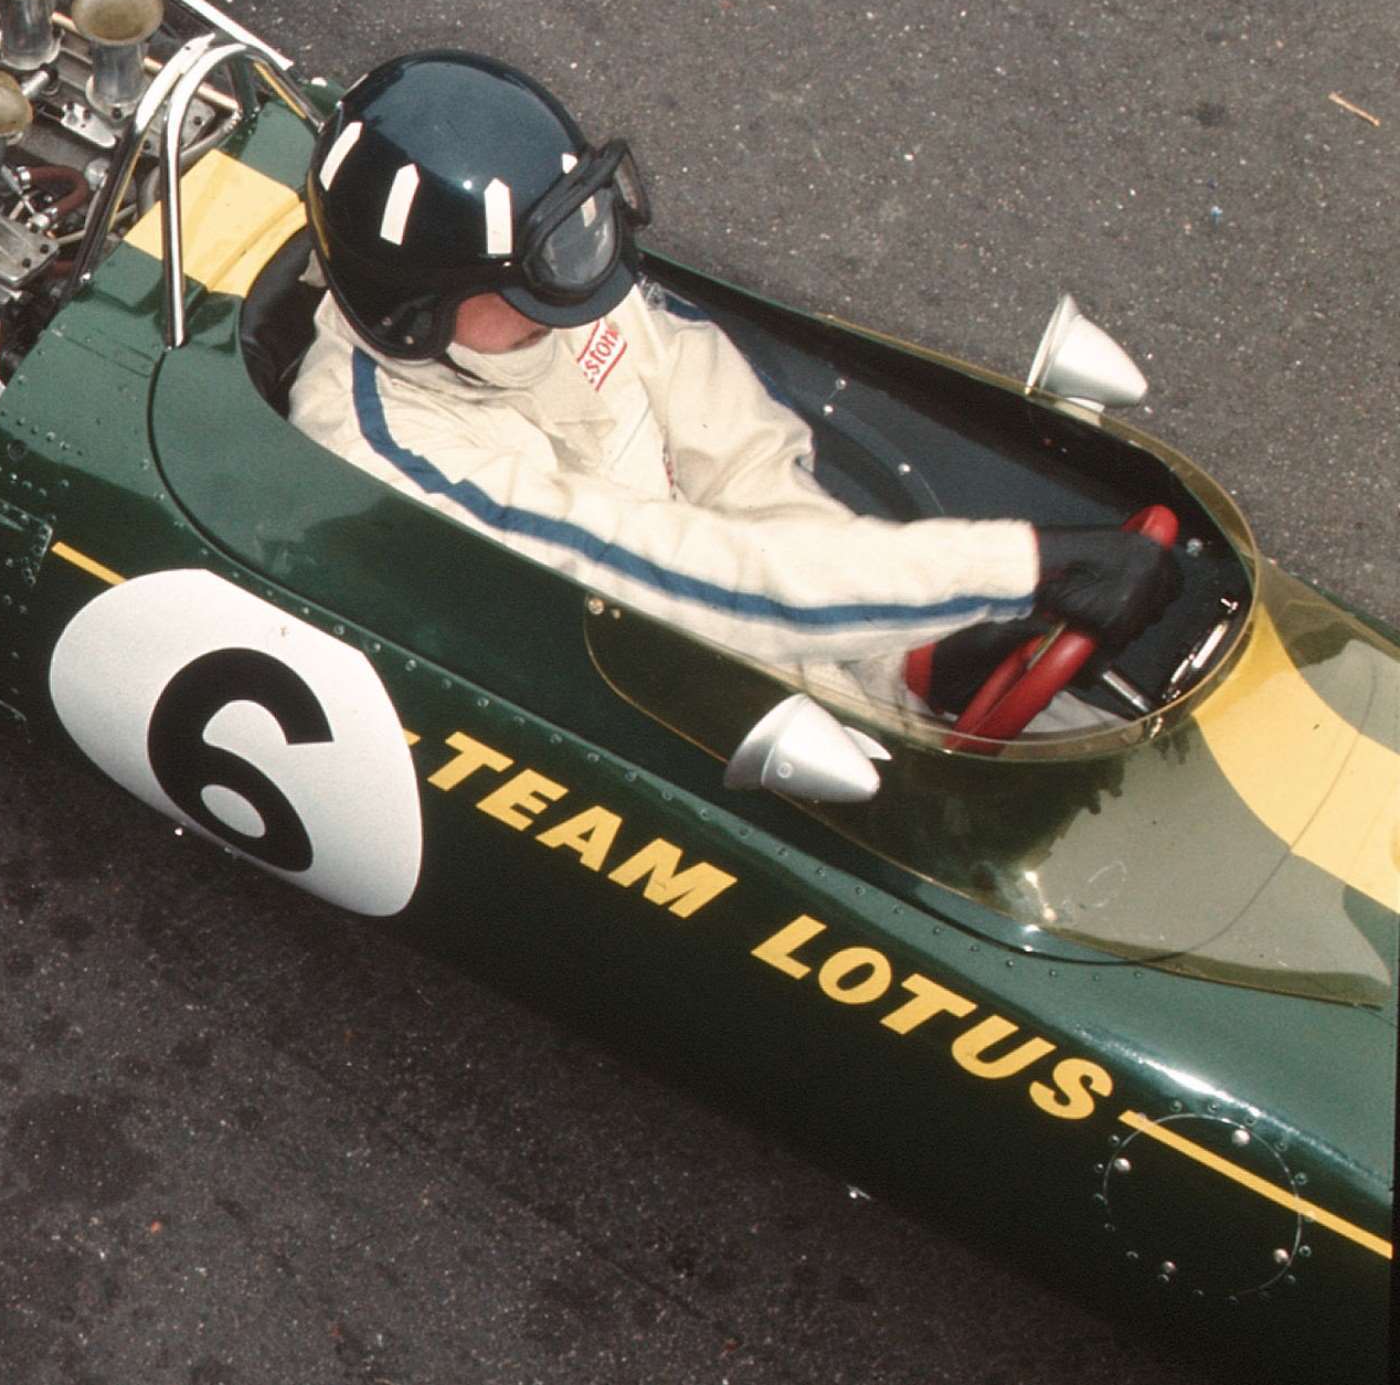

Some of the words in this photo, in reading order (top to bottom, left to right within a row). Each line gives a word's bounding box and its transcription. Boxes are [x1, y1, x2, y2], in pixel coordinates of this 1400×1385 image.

[147, 647, 335, 873] 6
[427, 730, 738, 919] TEAM
[751, 914, 1114, 1120] LOTUS
